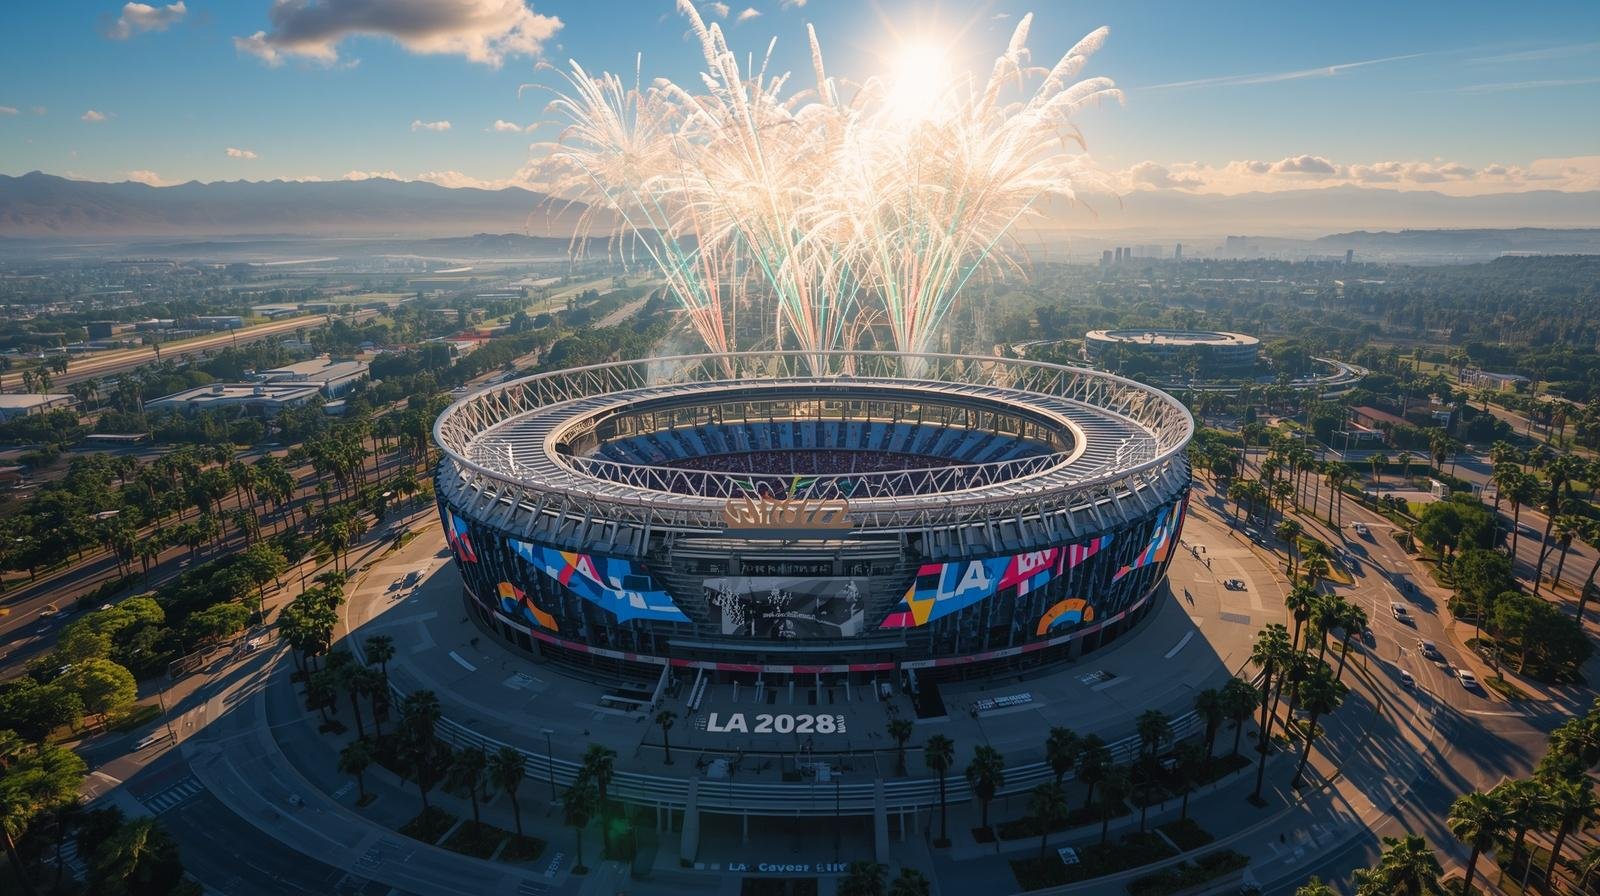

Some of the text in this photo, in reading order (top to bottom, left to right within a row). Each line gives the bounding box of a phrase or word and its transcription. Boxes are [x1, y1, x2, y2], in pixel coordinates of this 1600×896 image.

[936, 560, 989, 601] LA
[707, 712, 748, 733] LA
[754, 713, 836, 734] 2028
